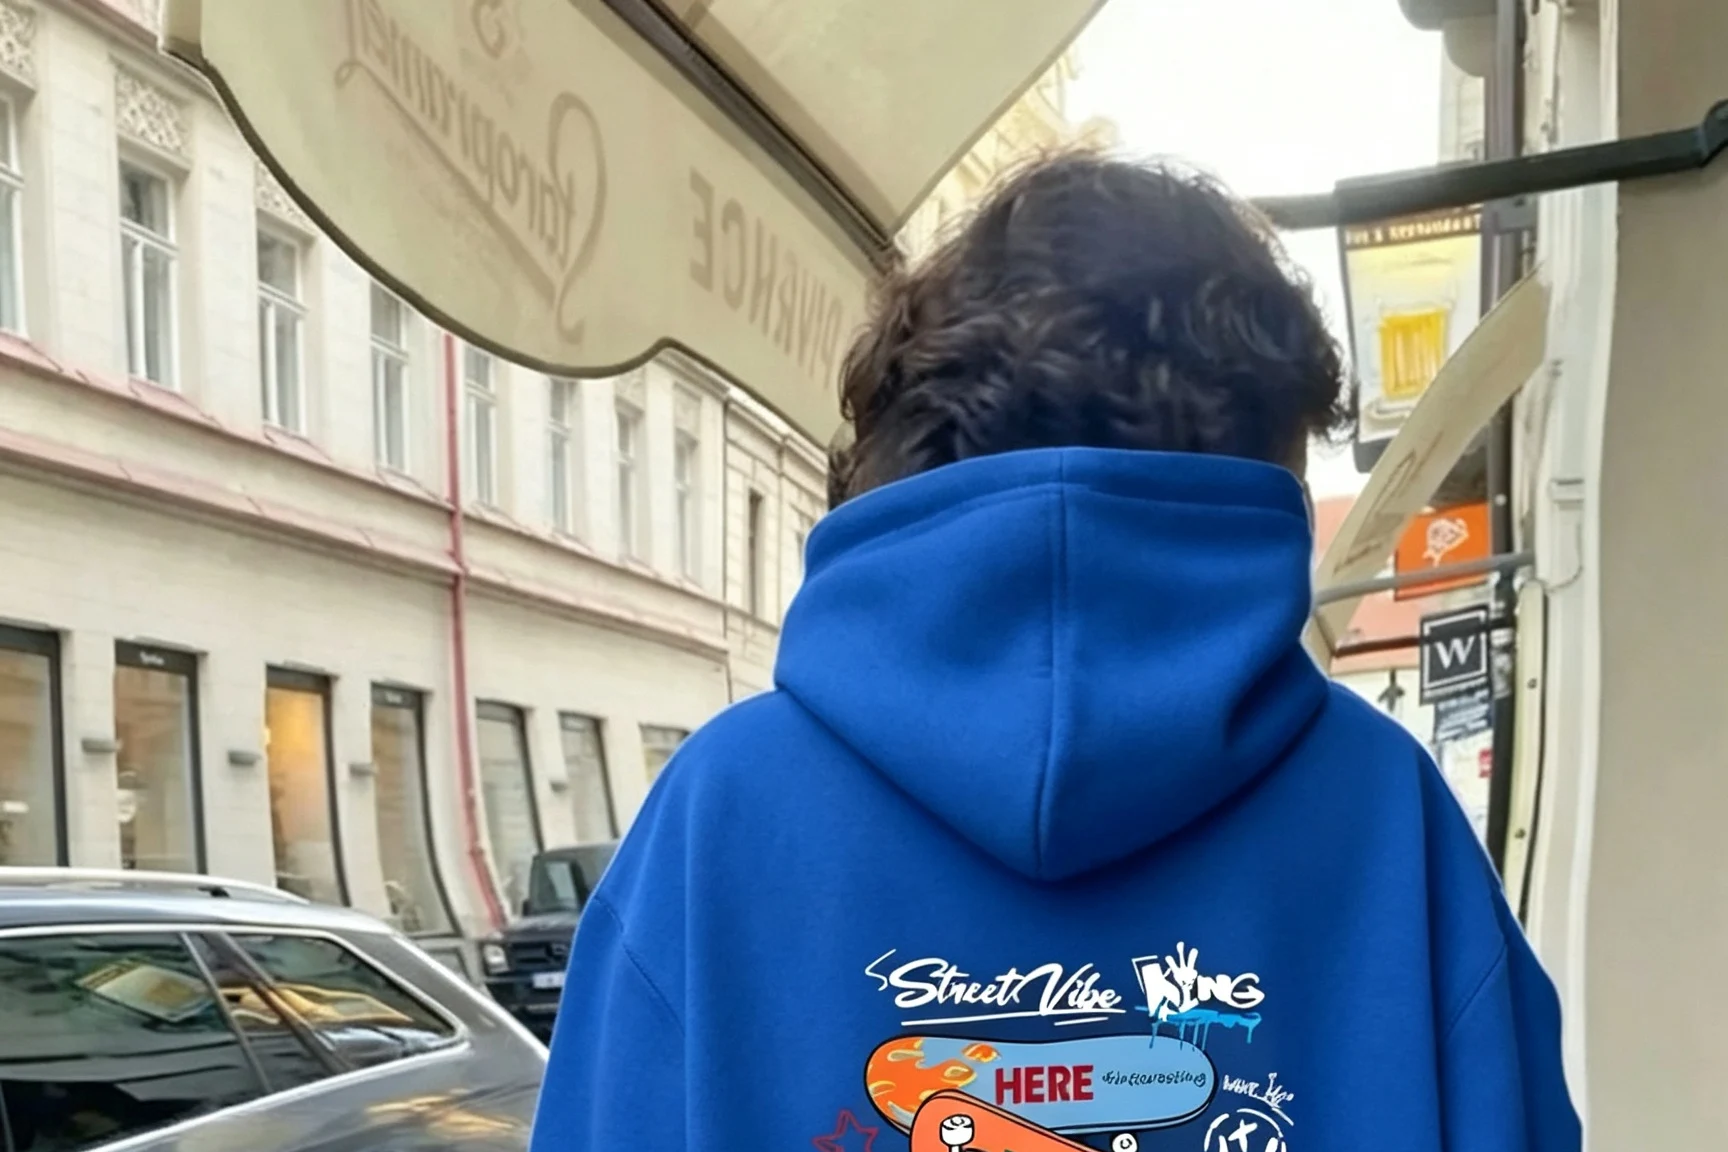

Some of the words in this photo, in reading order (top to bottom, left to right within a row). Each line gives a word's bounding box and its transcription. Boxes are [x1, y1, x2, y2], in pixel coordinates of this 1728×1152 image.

[1435, 634, 1476, 669] W
[888, 957, 1025, 1009] Street
[1012, 962, 1123, 1017] Vibe
[995, 1064, 1095, 1106] HERE
